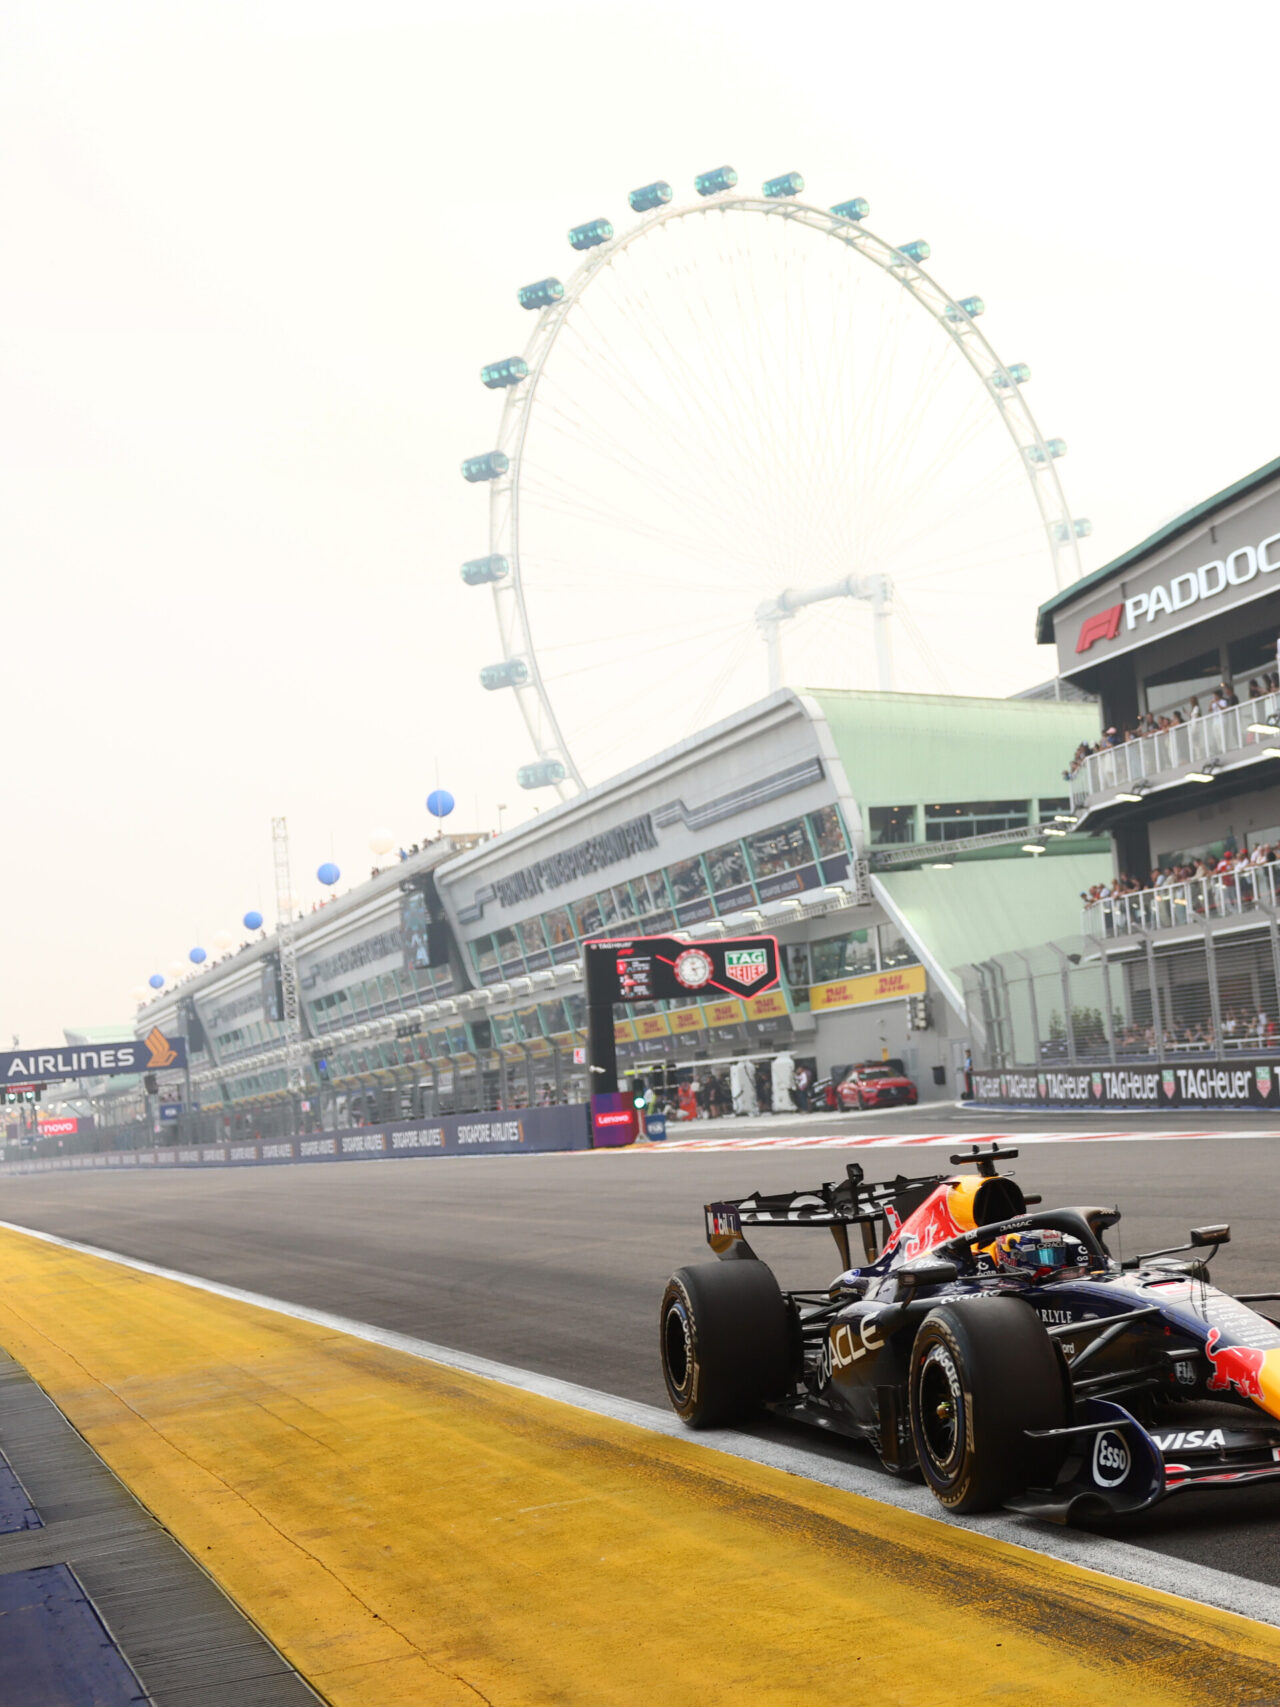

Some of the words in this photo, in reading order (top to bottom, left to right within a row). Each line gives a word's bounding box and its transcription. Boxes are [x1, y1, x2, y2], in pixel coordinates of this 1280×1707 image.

[728, 951, 766, 964] TAG
[727, 964, 767, 986] HEUER
[8, 1048, 135, 1076] AIRLINES
[37, 1122, 73, 1133] novo
[598, 1114, 629, 1124] Lenovo
[817, 1311, 885, 1390] ORACLE
[1150, 1429, 1226, 1450] VISA
